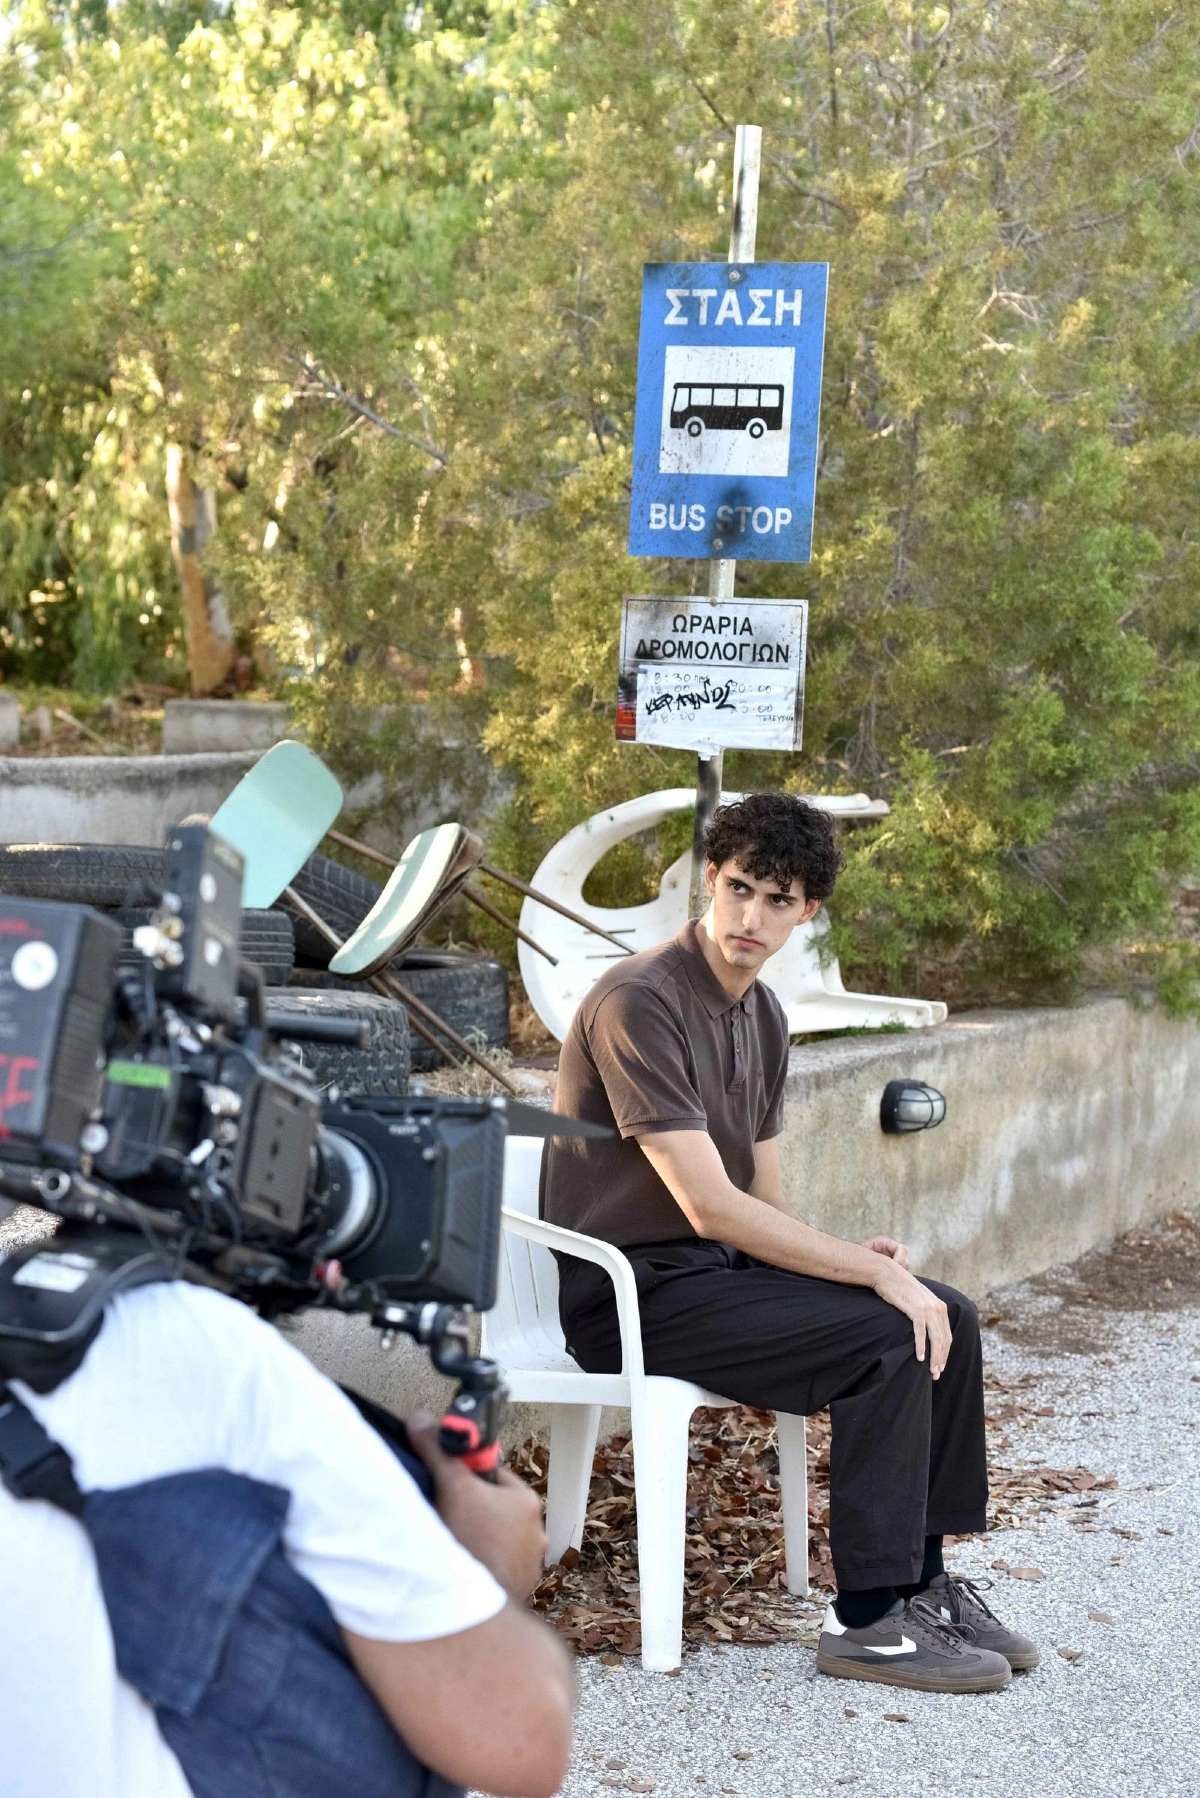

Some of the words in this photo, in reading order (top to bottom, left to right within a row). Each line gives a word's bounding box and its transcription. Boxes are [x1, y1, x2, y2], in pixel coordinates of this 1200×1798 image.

[663, 288, 803, 327] ΣΤΑΣΗ
[649, 503, 706, 531] BUS
[716, 506, 792, 534] STOP
[672, 614, 753, 636] ΩΡΑΡΙΑ
[634, 639, 789, 663] ΔΡΟΜΟΛΟΓΙΩΝ
